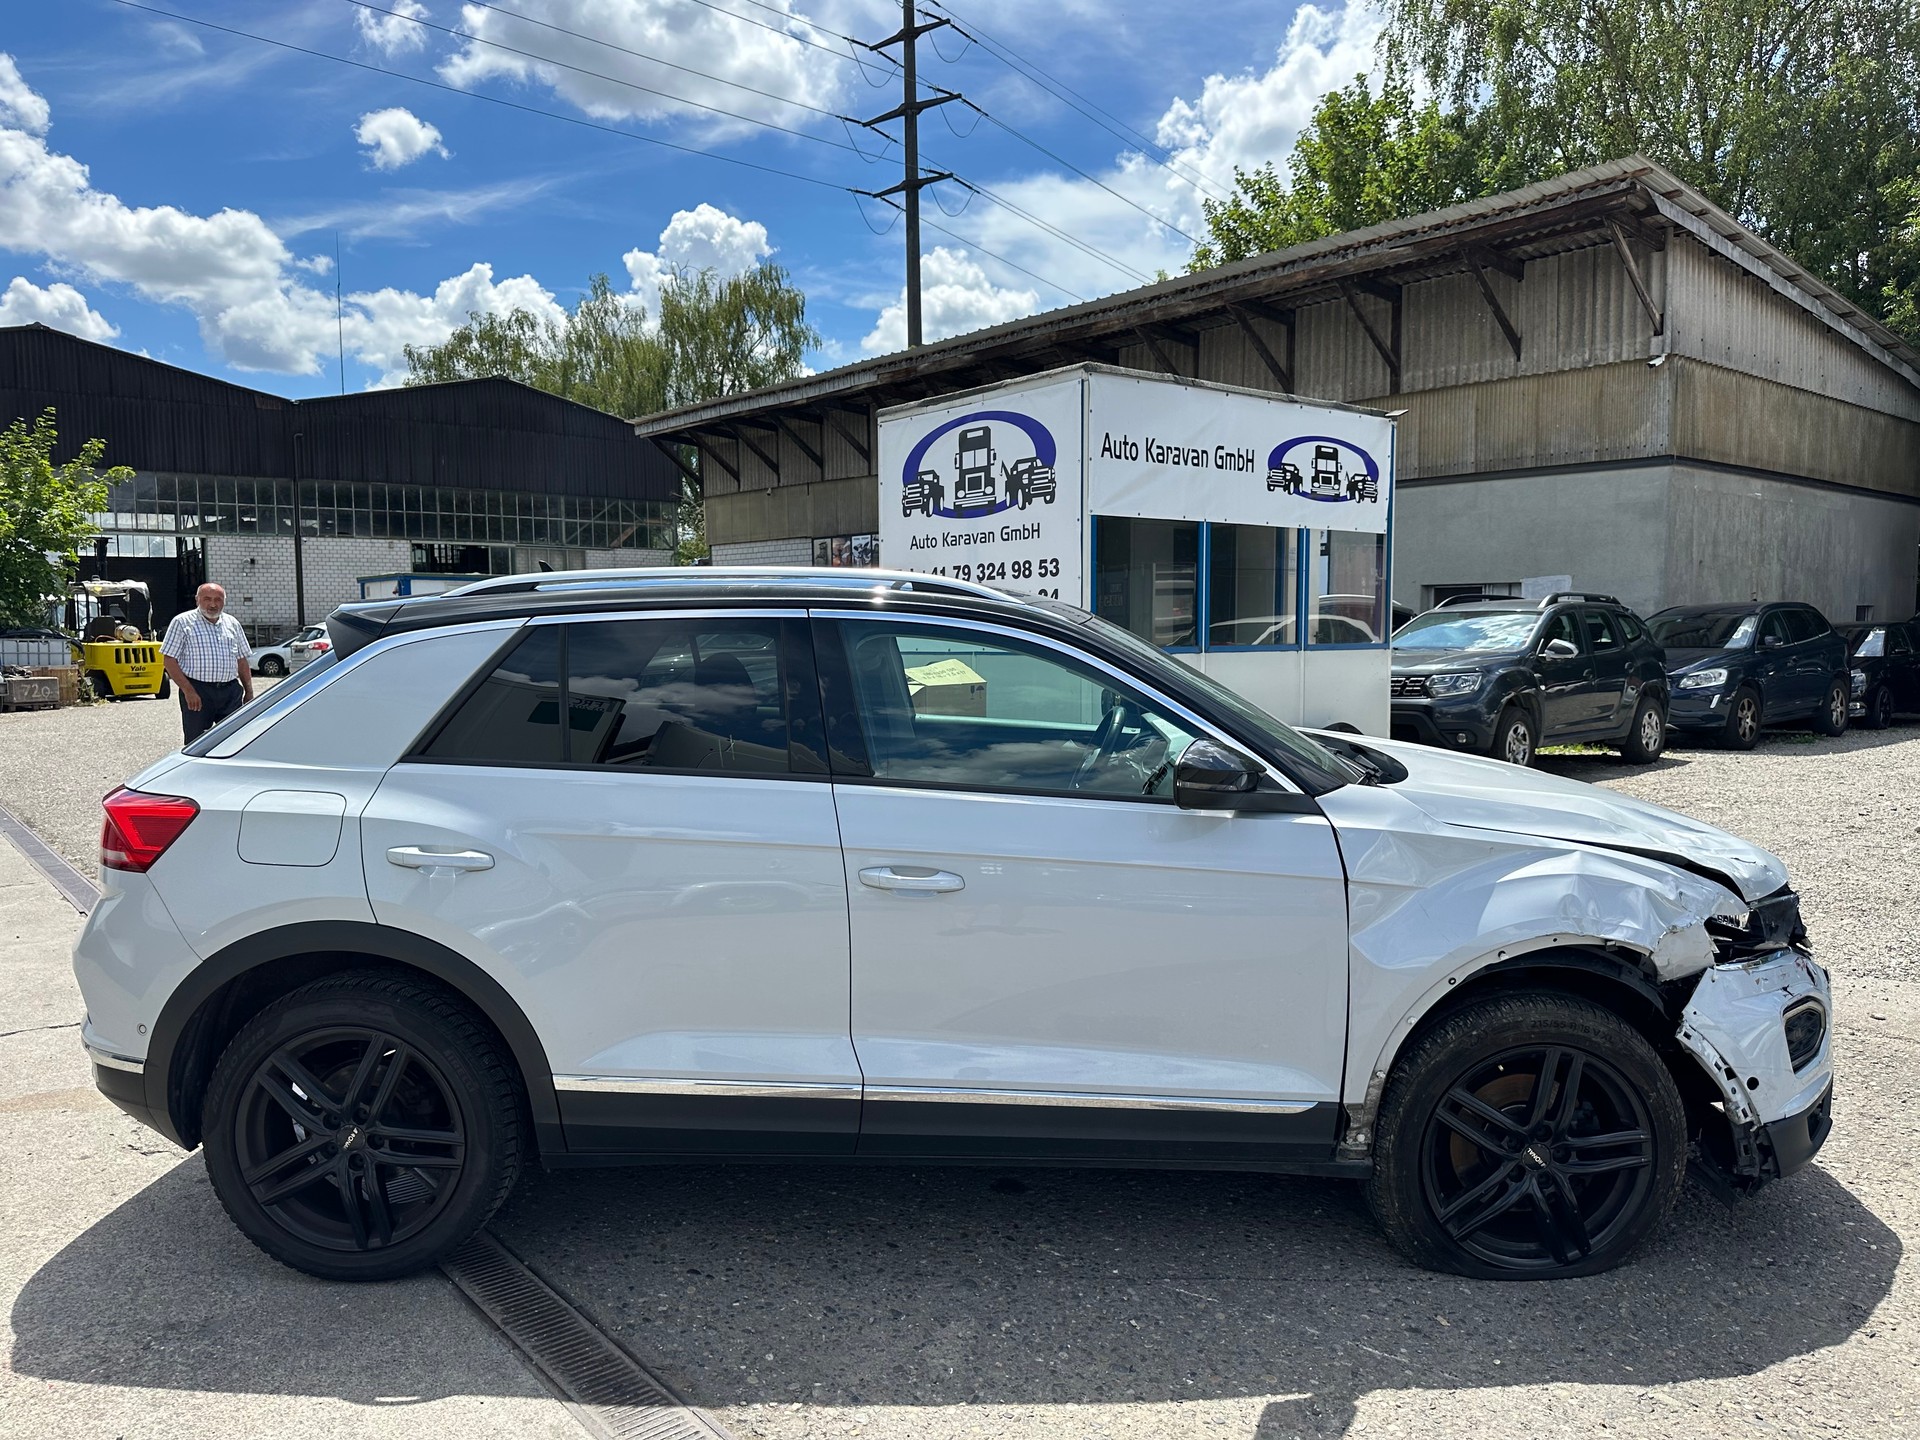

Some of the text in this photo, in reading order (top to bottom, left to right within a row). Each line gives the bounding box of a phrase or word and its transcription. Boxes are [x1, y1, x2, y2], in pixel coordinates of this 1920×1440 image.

[1101, 432, 1256, 473] Auto Karavan GmbH
[909, 522, 1041, 551] Auto Karavan GmbH
[952, 564, 972, 582] 79
[976, 562, 1007, 582] 324
[1011, 559, 1033, 580] 98
[1038, 557, 1060, 578] 53
